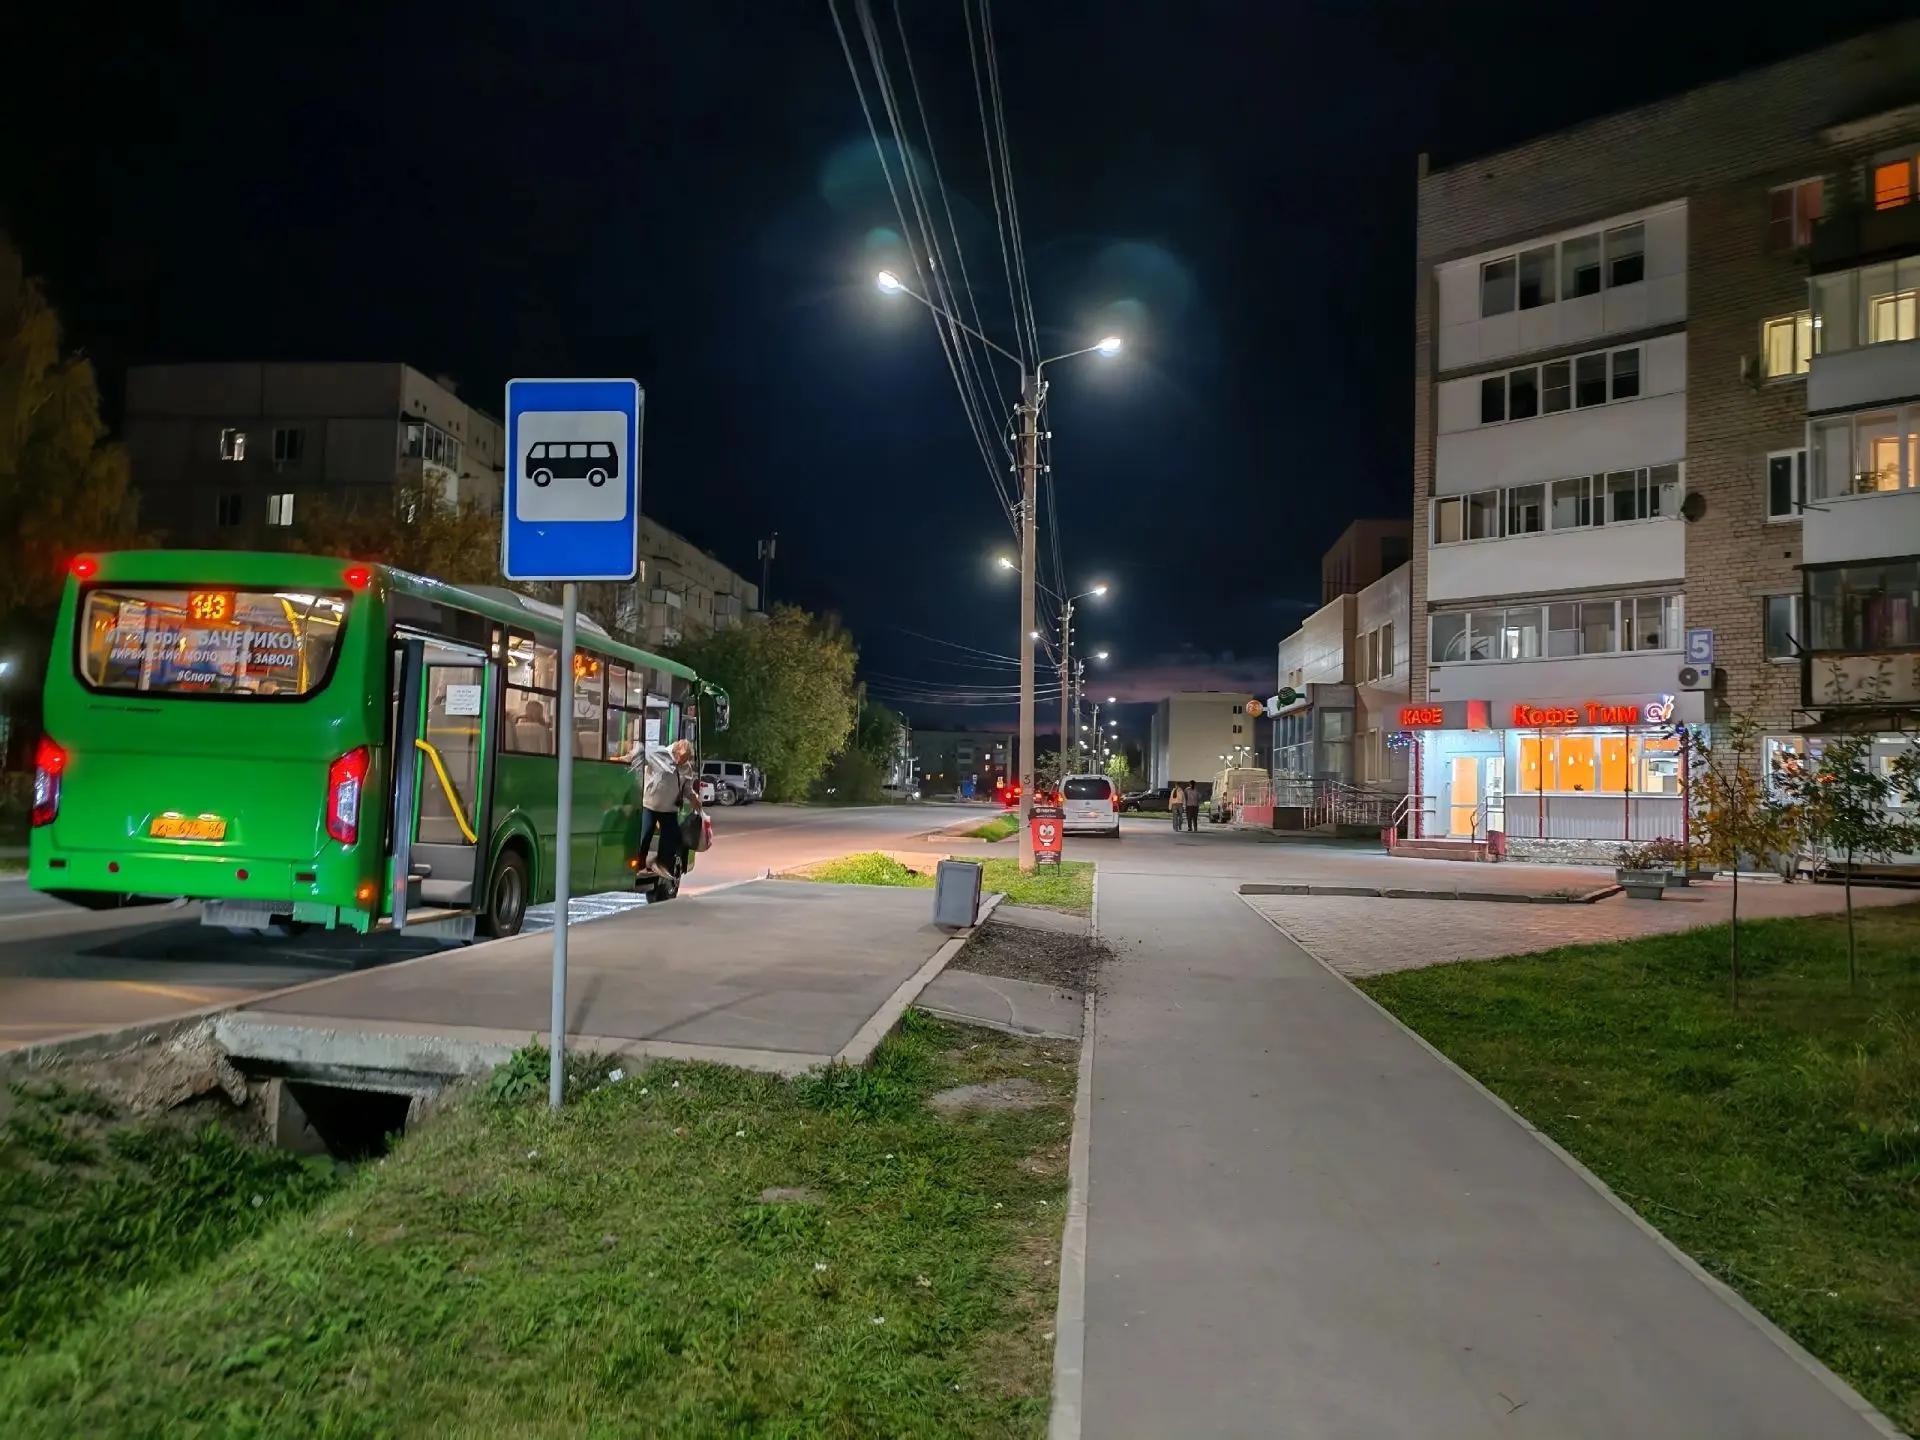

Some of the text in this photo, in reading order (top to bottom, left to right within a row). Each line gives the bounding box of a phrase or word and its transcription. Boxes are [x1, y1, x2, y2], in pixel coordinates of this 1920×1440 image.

[192, 594, 226, 619] 143
[1691, 634, 1710, 659] 5
[254, 653, 294, 667] ЗАВОД
[176, 670, 216, 685] #Спорт
[1402, 708, 1443, 725] КАФЕ
[1513, 702, 1639, 727] Кофе Тим
